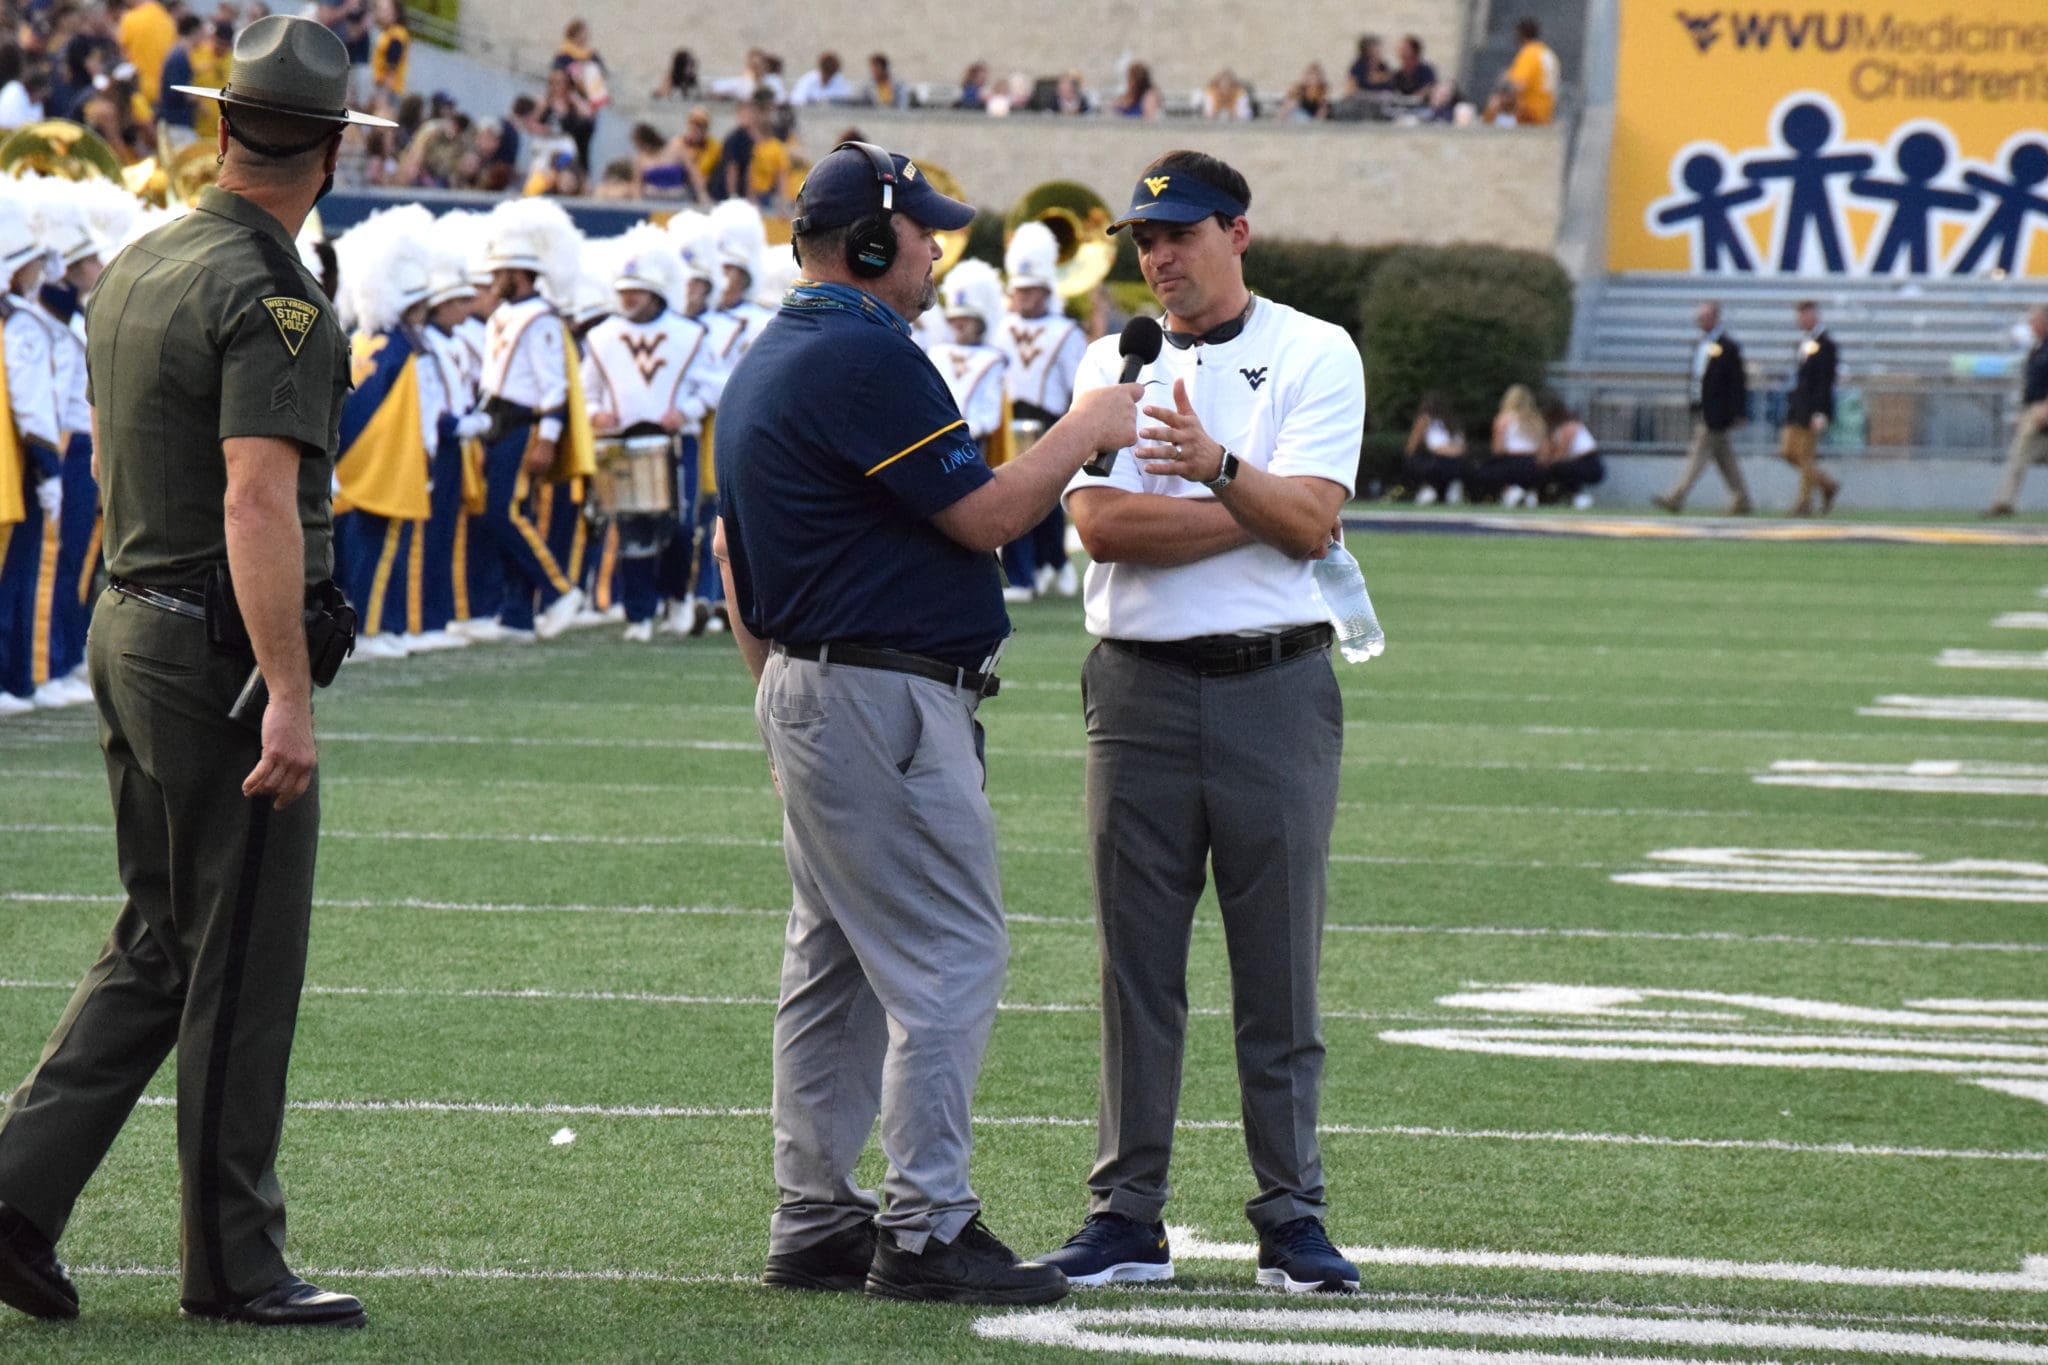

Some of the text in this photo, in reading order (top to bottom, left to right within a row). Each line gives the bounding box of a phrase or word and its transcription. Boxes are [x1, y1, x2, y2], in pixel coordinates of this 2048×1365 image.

[266, 300, 287, 309] WEST
[276, 308, 309, 324] STATE
[282, 319, 305, 333] POLICE
